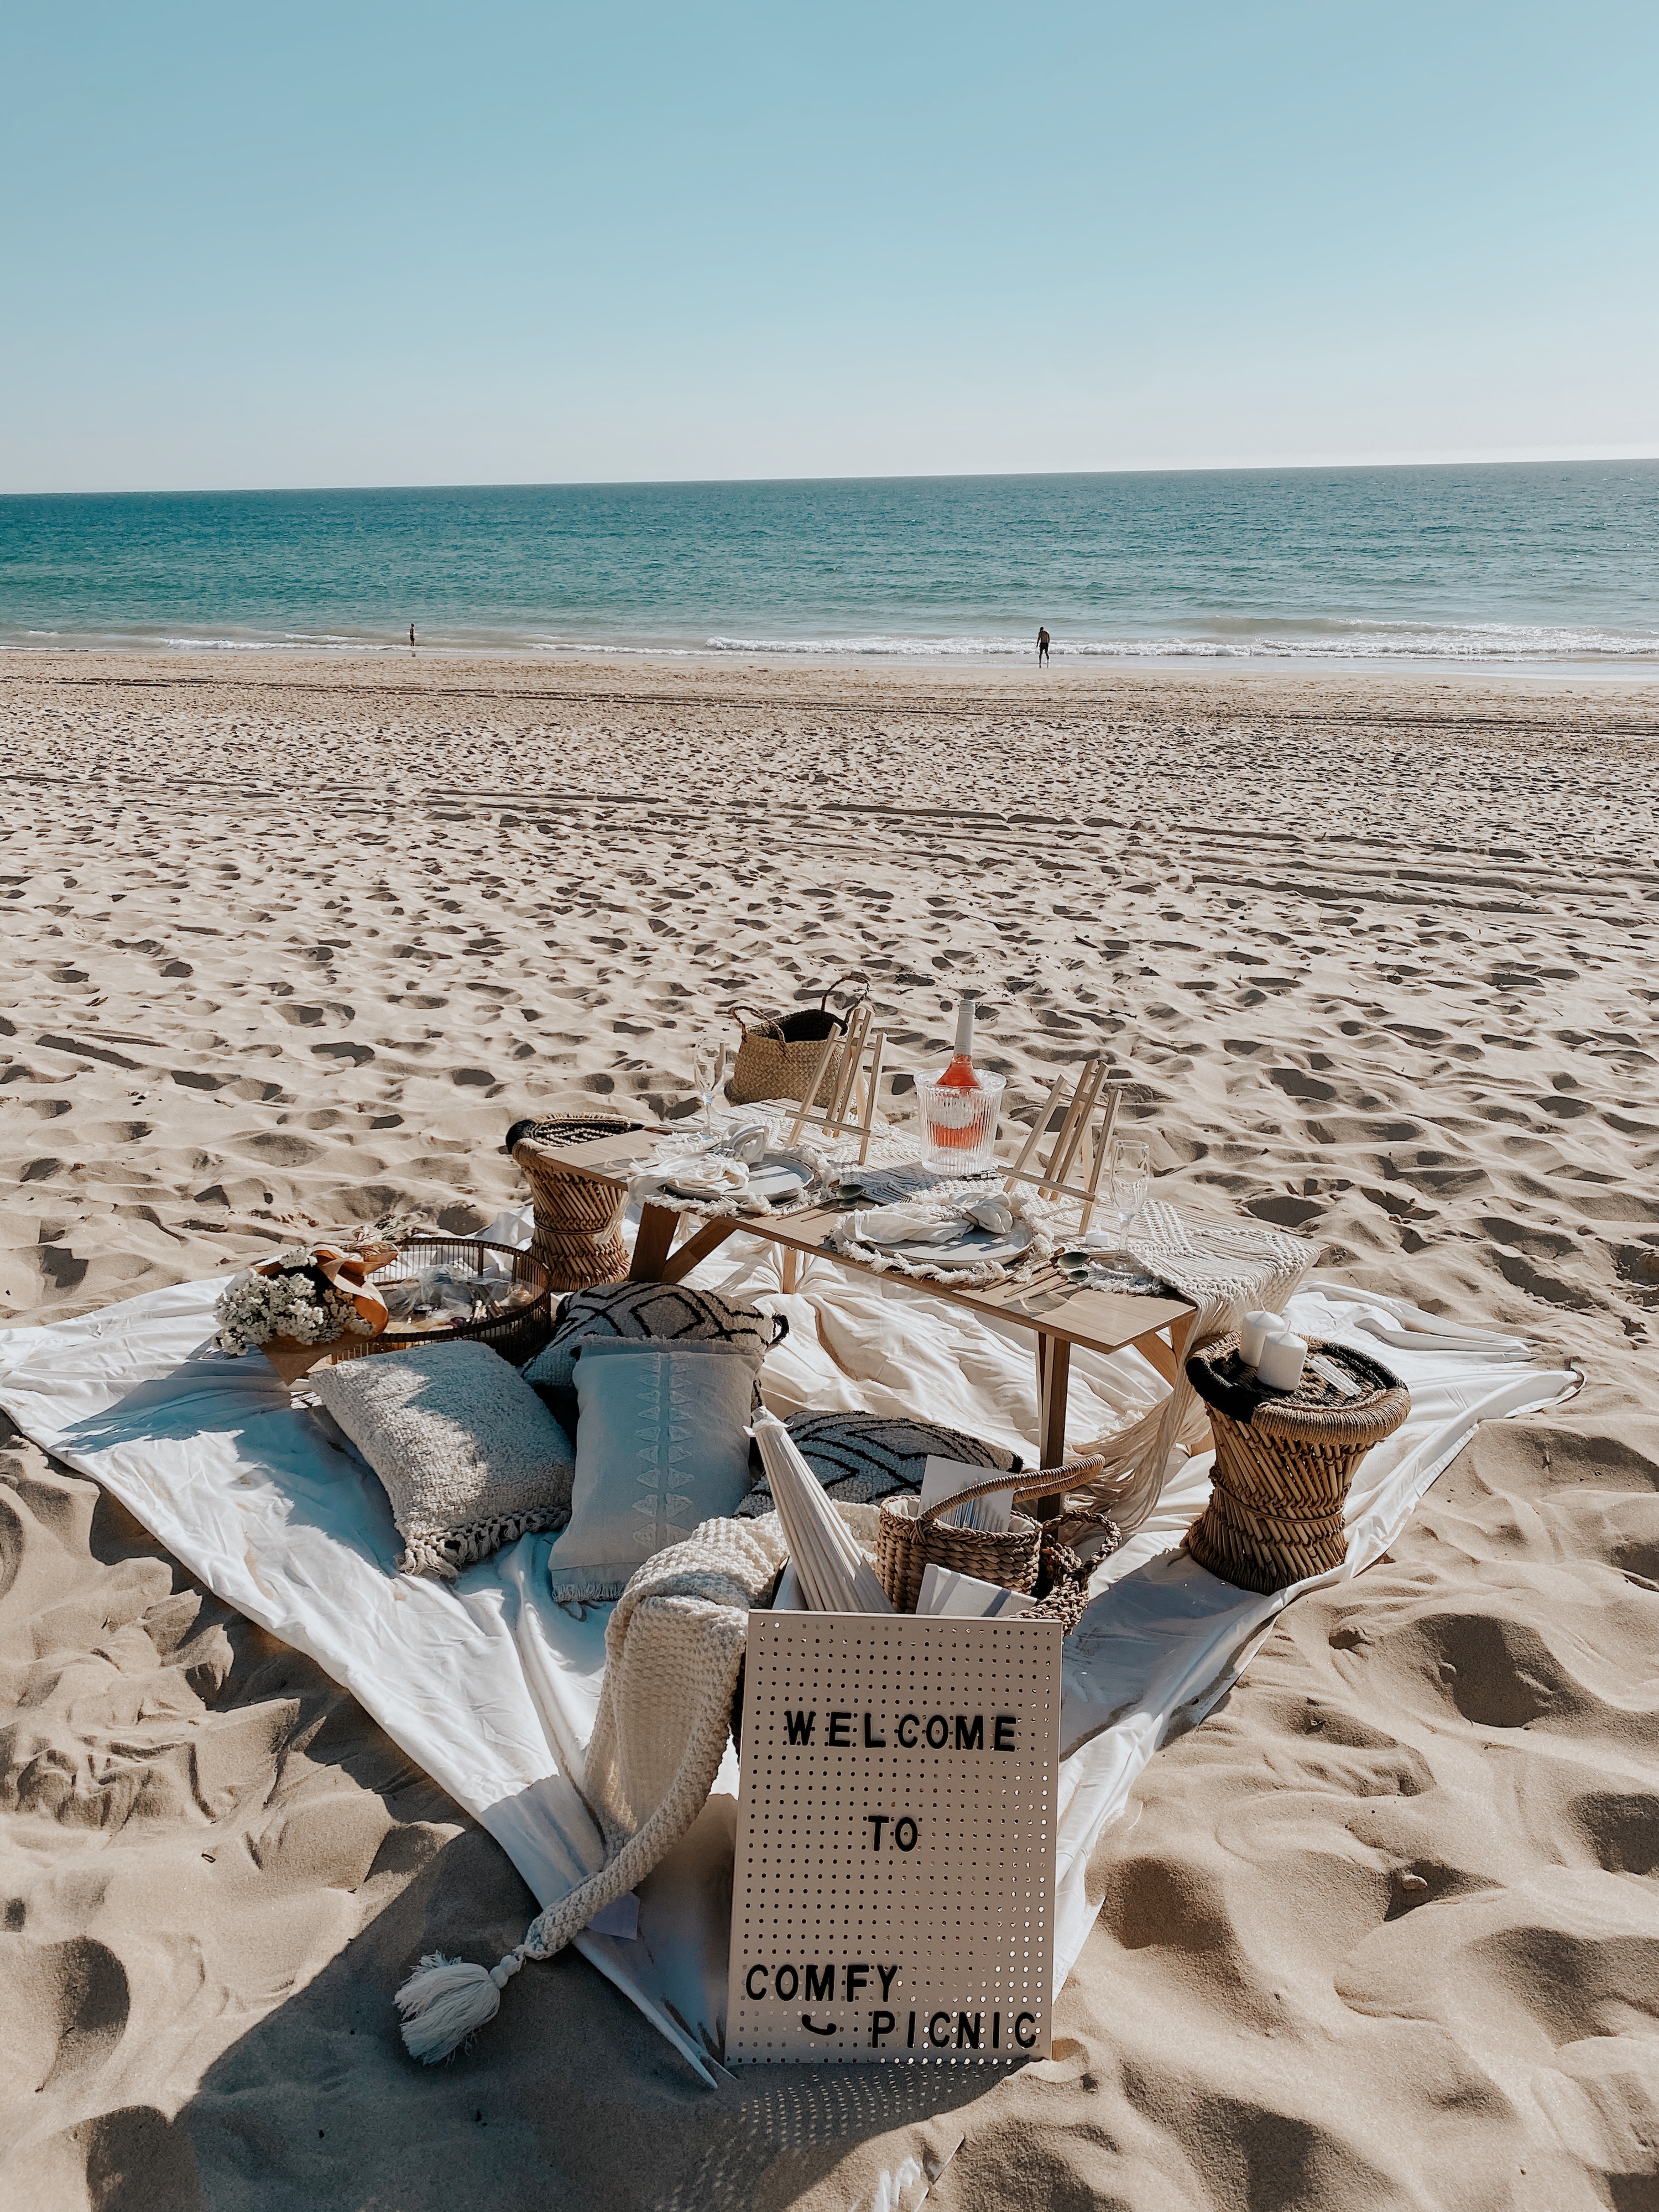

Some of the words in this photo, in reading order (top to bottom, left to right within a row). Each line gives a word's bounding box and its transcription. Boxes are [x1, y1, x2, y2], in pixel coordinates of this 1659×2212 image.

[785, 1710, 1016, 1752] WELCOME
[868, 1815, 919, 1851] TO
[745, 1964, 898, 2002] COMFY
[872, 2011, 1036, 2049] PICNIC
